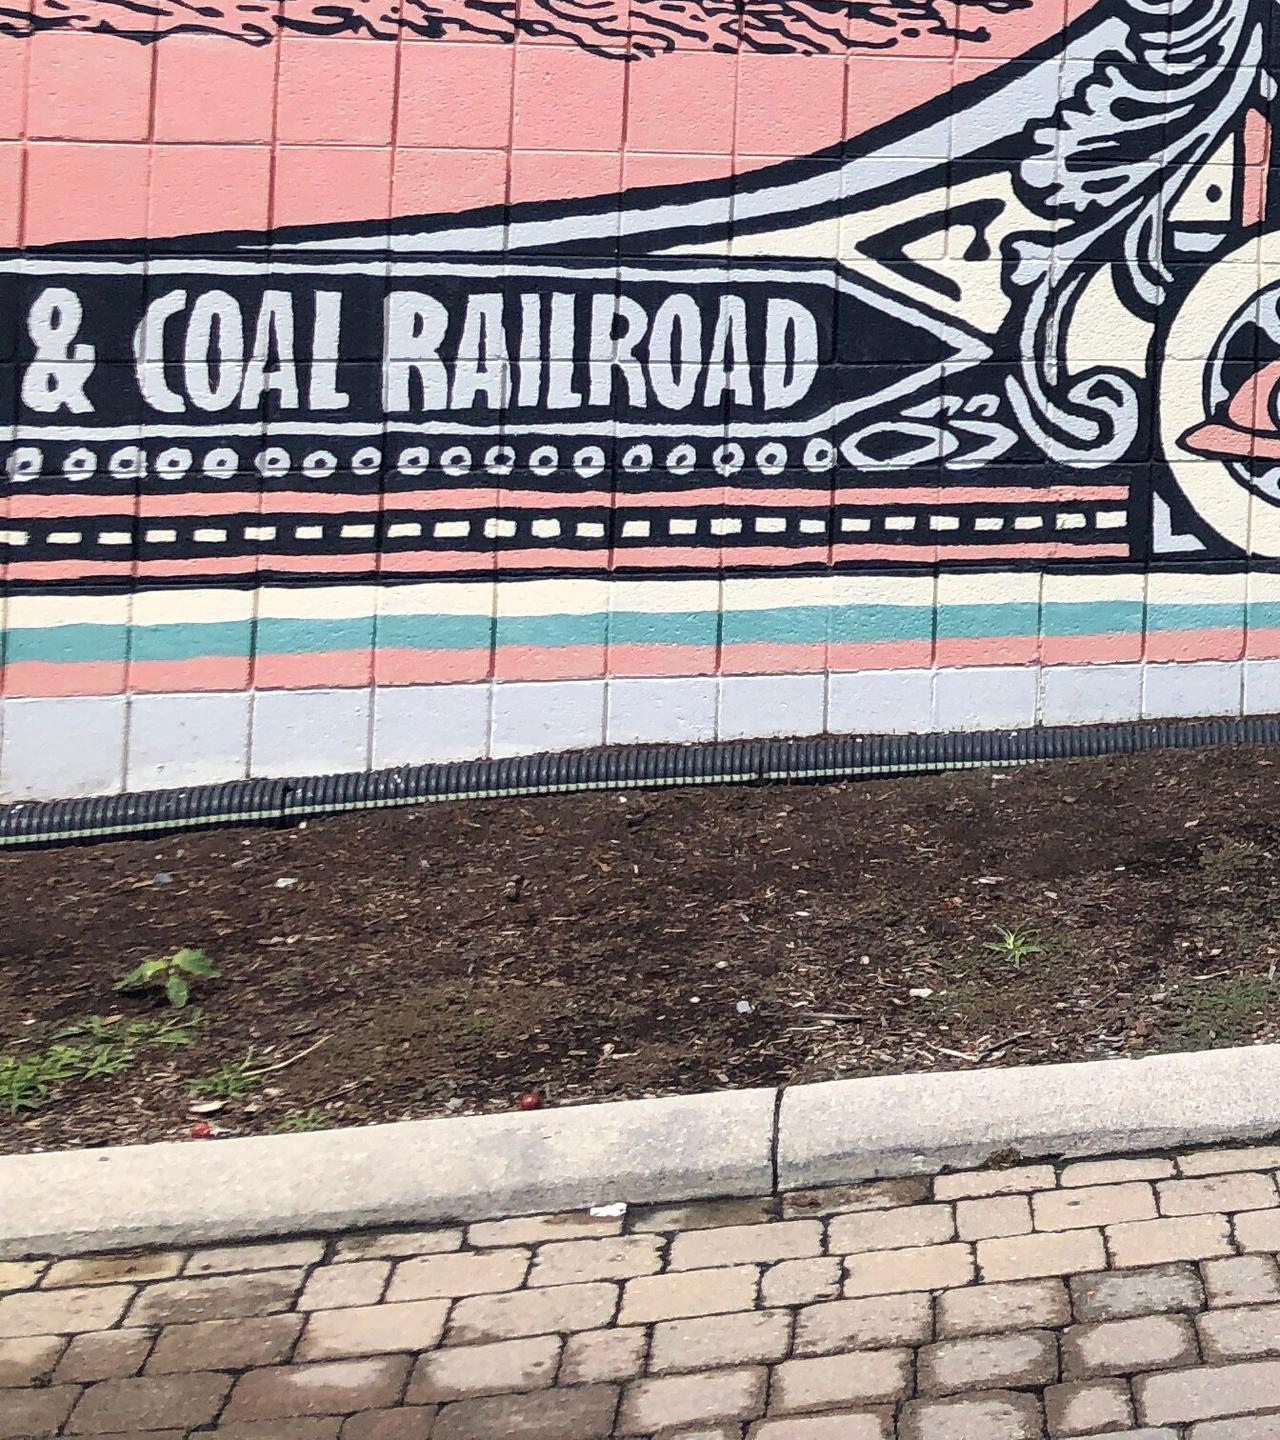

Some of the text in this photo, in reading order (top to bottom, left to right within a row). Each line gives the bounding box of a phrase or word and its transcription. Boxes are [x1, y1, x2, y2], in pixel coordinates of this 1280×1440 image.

[20, 287, 819, 414] & COAL RAILROAD
